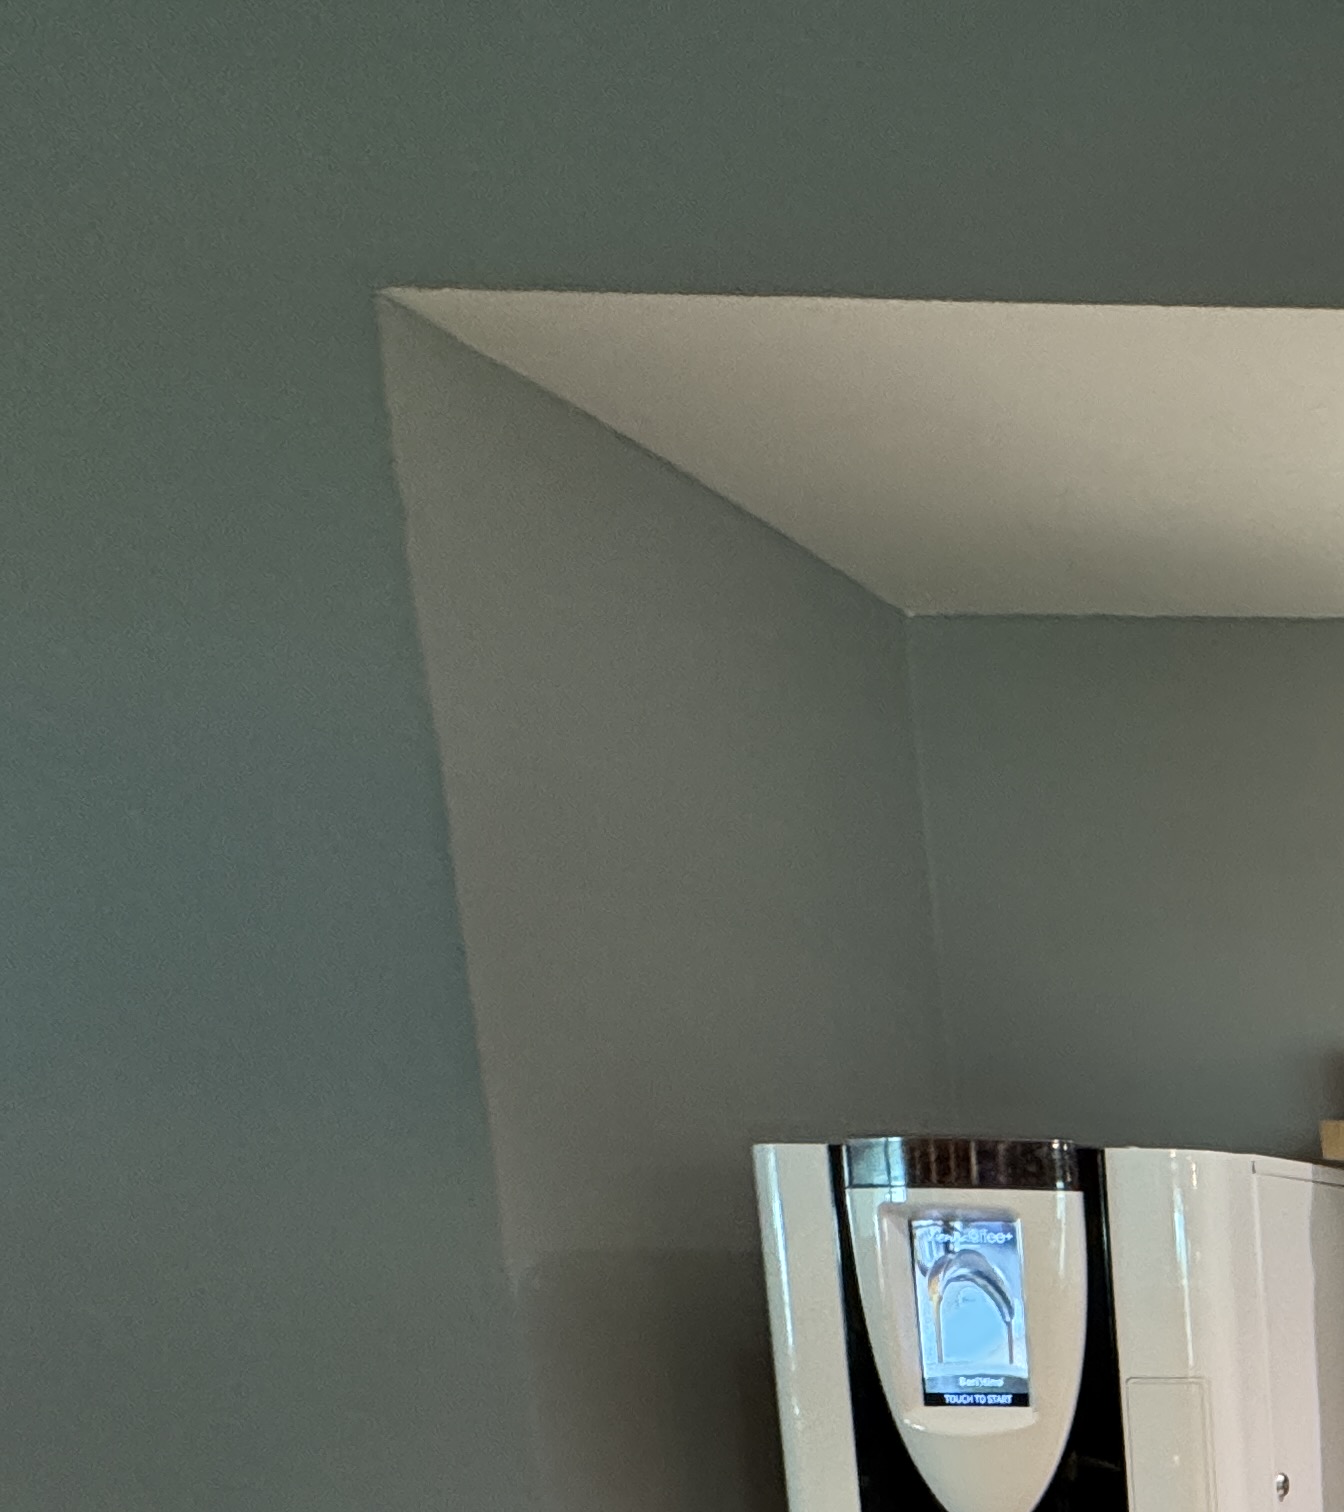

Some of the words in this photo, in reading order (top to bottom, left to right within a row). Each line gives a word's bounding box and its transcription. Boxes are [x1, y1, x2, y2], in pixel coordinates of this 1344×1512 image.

[943, 1394, 974, 1405] TOUCH
[974, 1394, 986, 1405] TO
[987, 1394, 1013, 1405] START
